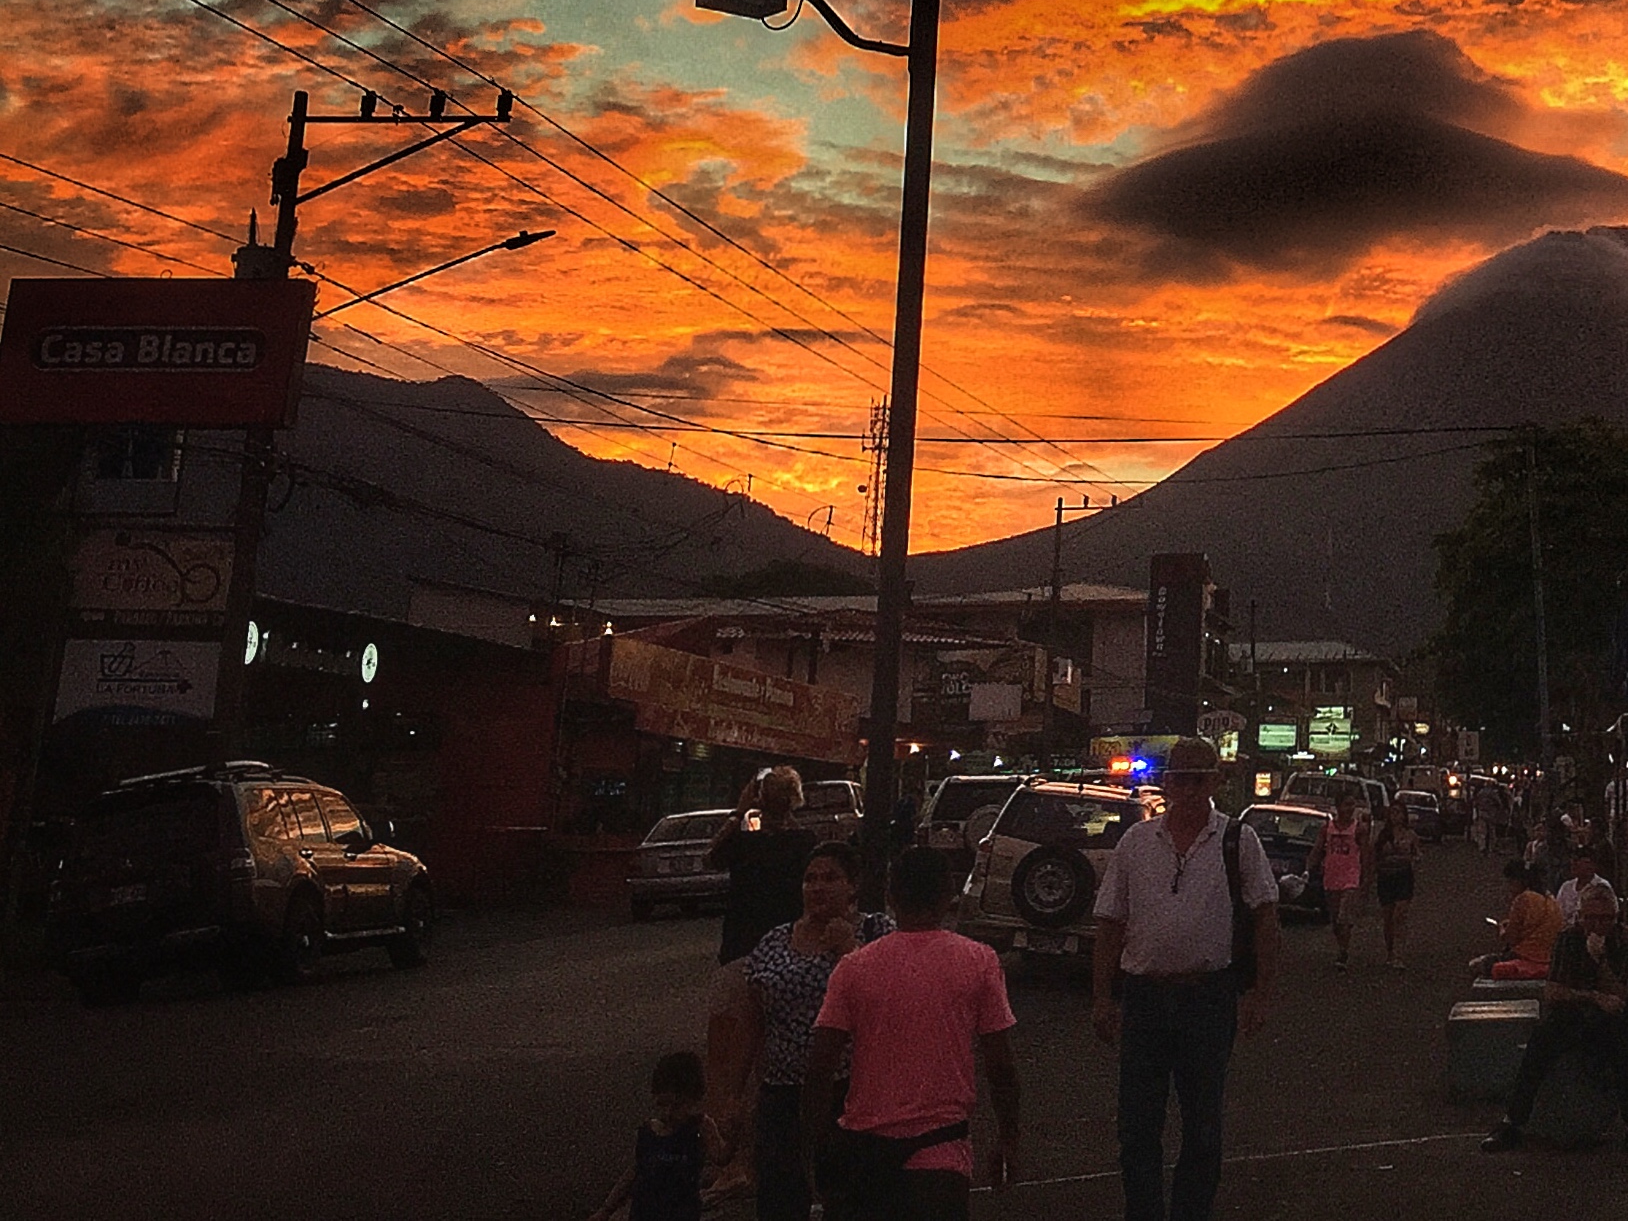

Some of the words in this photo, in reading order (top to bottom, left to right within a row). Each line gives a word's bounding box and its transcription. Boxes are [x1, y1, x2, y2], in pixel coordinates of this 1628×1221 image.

[40, 333, 126, 365] Casa
[136, 333, 258, 365] Blanca
[96, 683, 113, 695] LA
[115, 684, 175, 696] FORTUNA
